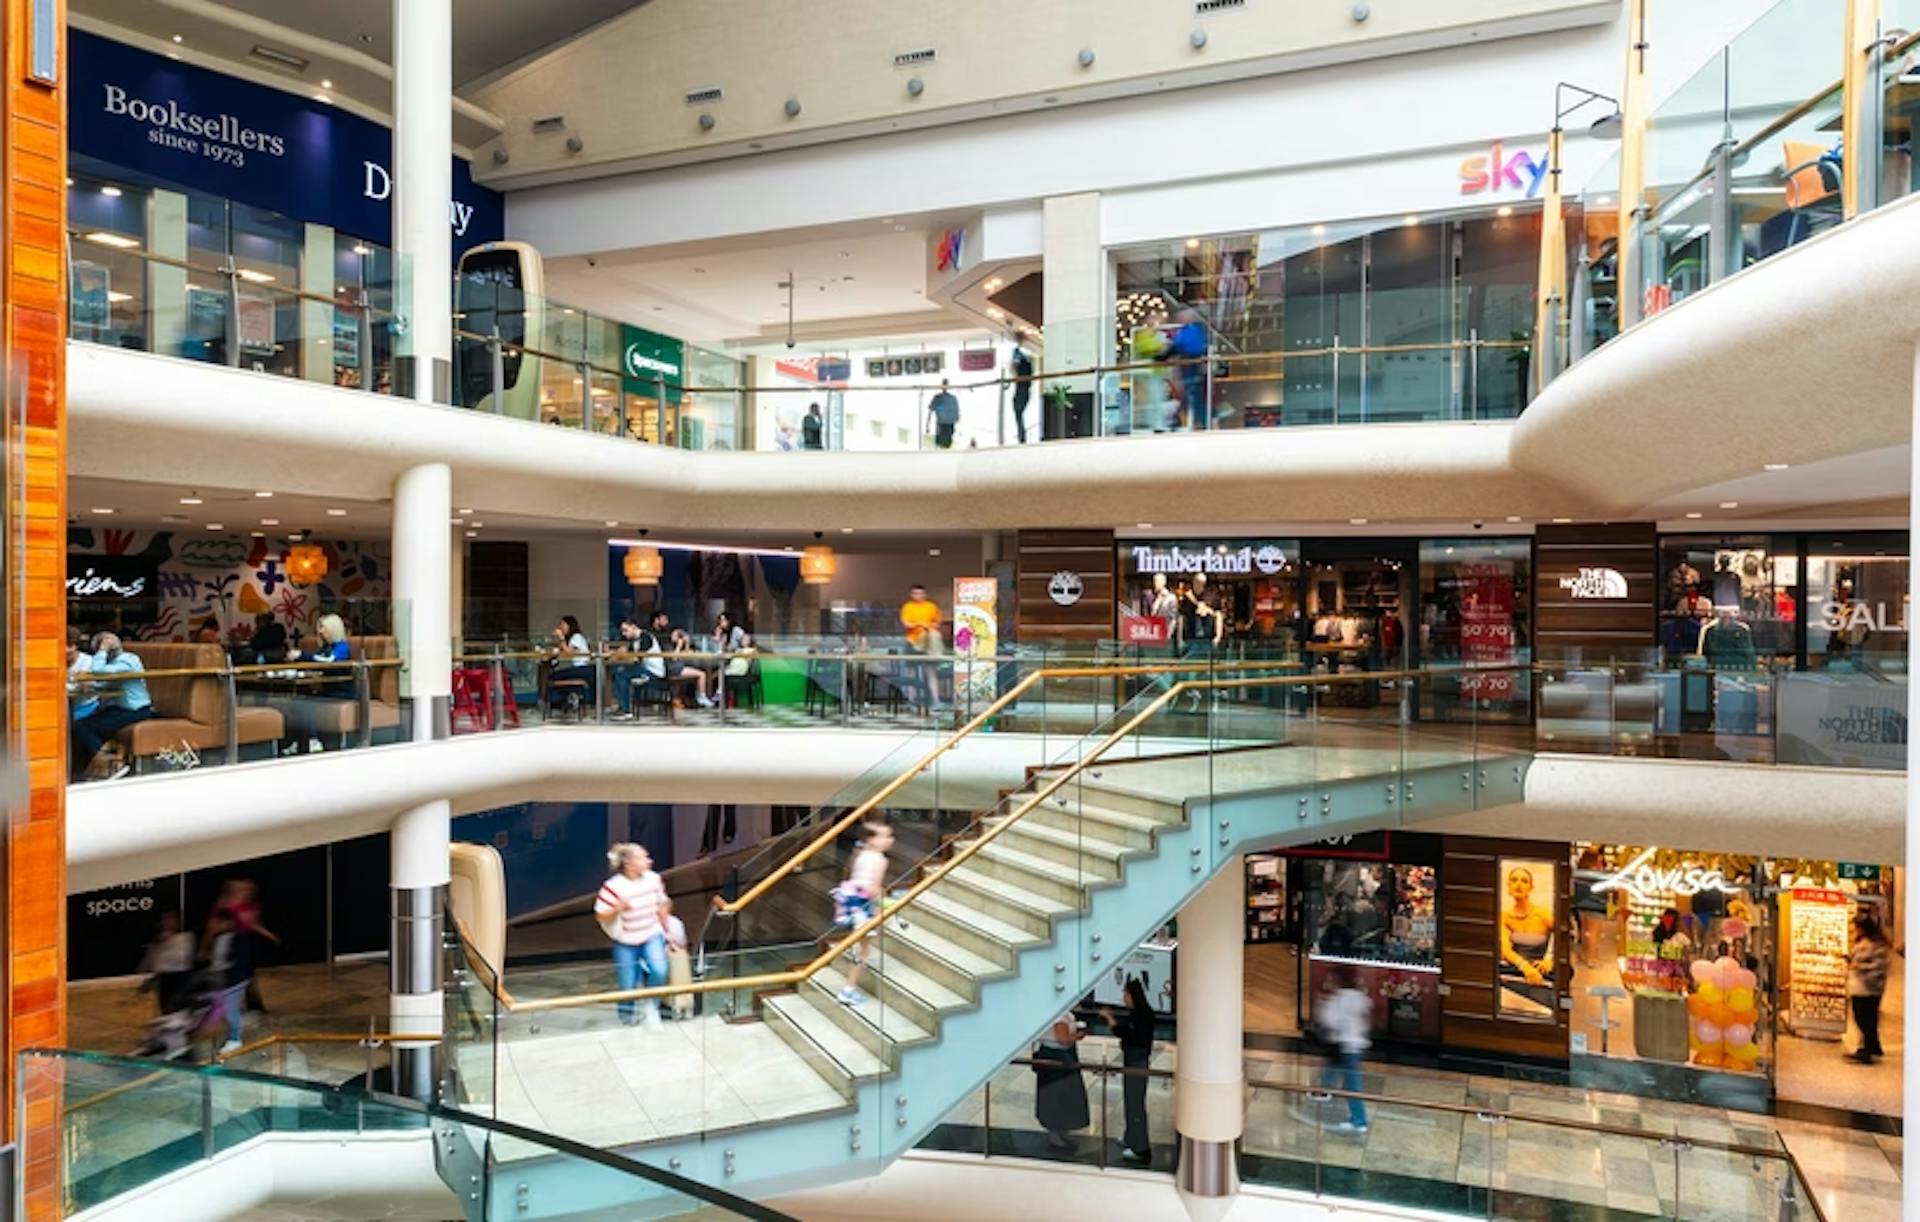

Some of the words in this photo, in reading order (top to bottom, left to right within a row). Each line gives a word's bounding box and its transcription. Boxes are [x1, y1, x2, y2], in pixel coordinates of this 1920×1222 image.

[103, 83, 286, 157] Booksellers
[147, 127, 200, 154] since
[202, 142, 246, 168] 1973
[1459, 139, 1549, 198] sky
[1132, 545, 1252, 573] Timberland
[1129, 623, 1162, 641] SALE
[1818, 717, 1880, 731] NORTH
[1847, 705, 1881, 719] THE
[1835, 730, 1880, 744] FACE
[1590, 846, 1745, 907] Lovisa
[86, 897, 154, 917] space
